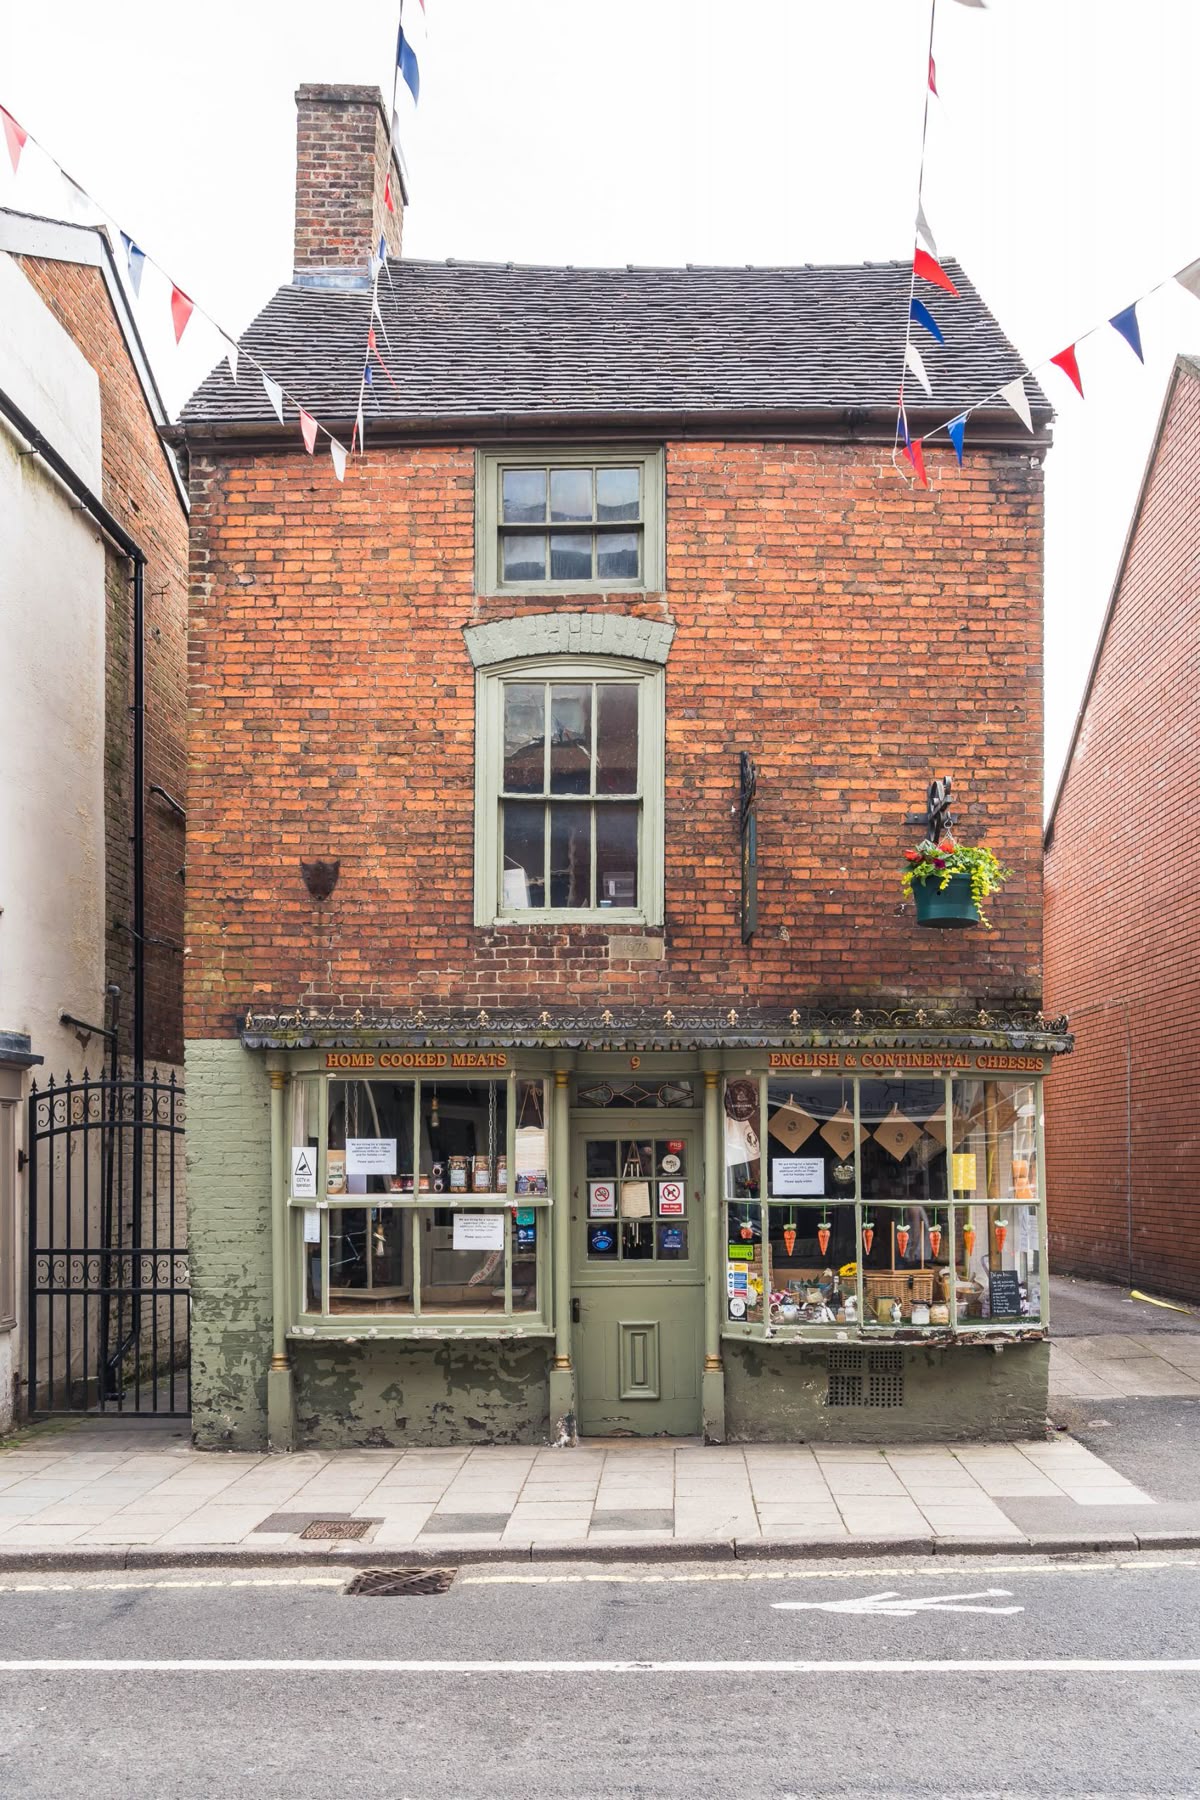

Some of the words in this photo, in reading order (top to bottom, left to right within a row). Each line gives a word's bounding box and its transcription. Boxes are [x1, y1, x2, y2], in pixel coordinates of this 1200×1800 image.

[326, 1053, 375, 1068] HOME
[379, 1053, 447, 1068] COOKED
[451, 1053, 507, 1068] MEATS
[630, 1055, 641, 1070] 9
[769, 1053, 840, 1067] ENGLISH
[844, 1053, 857, 1067] &
[860, 1053, 972, 1068] CONTINENTAL
[975, 1055, 1045, 1071] CHEESES
